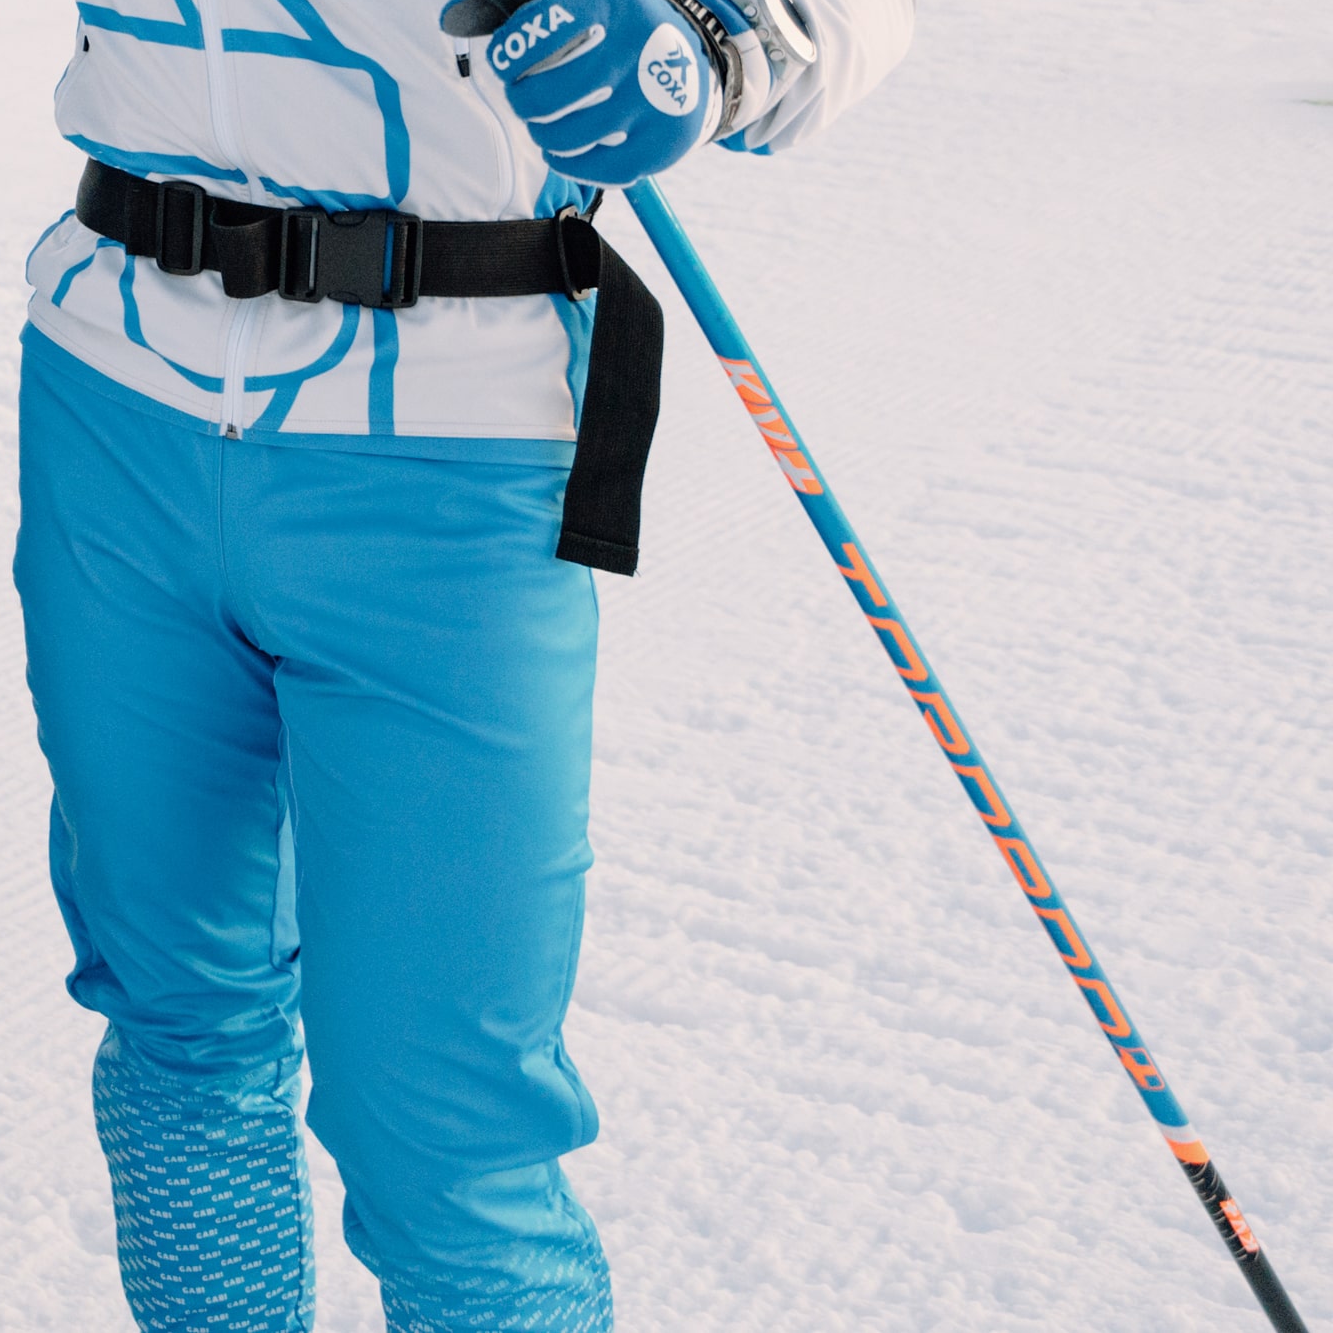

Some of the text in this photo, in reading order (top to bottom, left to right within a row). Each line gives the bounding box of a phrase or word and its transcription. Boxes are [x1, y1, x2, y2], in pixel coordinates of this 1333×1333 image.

[492, 4, 575, 71] COXA
[647, 60, 688, 109] COXA
[227, 1135, 249, 1147] GABI
[186, 1162, 209, 1173] GABI
[246, 1158, 268, 1169] GABI
[208, 1168, 230, 1180] GABI
[166, 1178, 190, 1186] GABI
[189, 1185, 212, 1196] GABI
[211, 1191, 233, 1202] GABI
[169, 1200, 193, 1208] GABI
[233, 1196, 255, 1209] GABI
[149, 1208, 172, 1219] GABI
[193, 1207, 216, 1218] GABI
[172, 1222, 196, 1230] GABI
[196, 1228, 218, 1239] GABI
[218, 1234, 239, 1246] GABI
[239, 1239, 261, 1251] GABI
[199, 1250, 221, 1260] GABI
[221, 1256, 242, 1266] GABI
[241, 1260, 262, 1271] GABI
[261, 1264, 282, 1276] GABI
[202, 1271, 224, 1281] GABI
[223, 1276, 245, 1288] GABI
[244, 1281, 266, 1293] GABI
[182, 1286, 205, 1294] GABI
[205, 1293, 228, 1304] GABI
